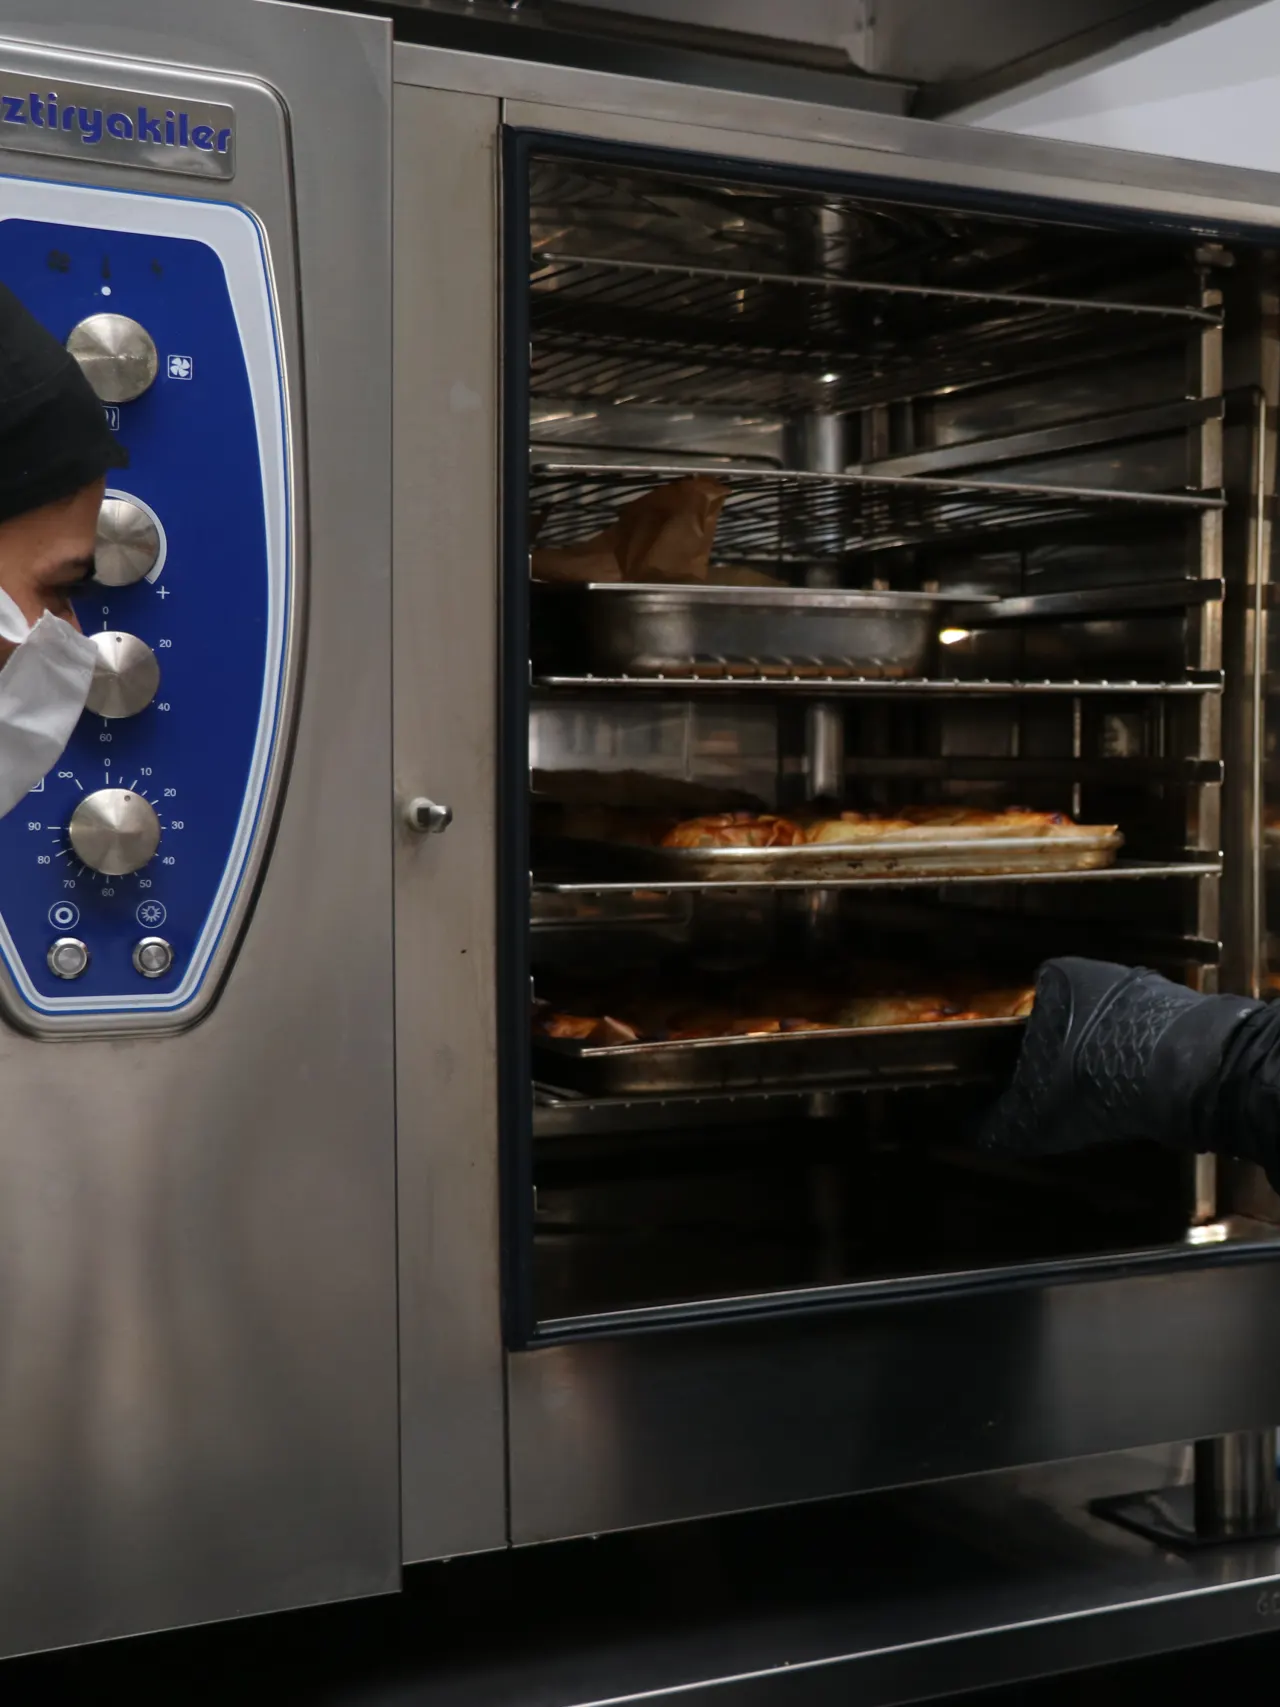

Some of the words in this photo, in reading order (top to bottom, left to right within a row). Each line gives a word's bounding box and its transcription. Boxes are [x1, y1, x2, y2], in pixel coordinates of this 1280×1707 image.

[159, 638, 172, 649] 20
[157, 702, 170, 712] 40
[99, 733, 112, 743] 60
[140, 767, 152, 776] 10
[163, 788, 177, 797] 20
[28, 822, 41, 831] 90
[171, 821, 184, 830] 30
[37, 855, 50, 865] 80
[162, 856, 175, 866] 40
[63, 879, 76, 889] 70
[139, 879, 152, 889] 50
[101, 888, 114, 897] 60
